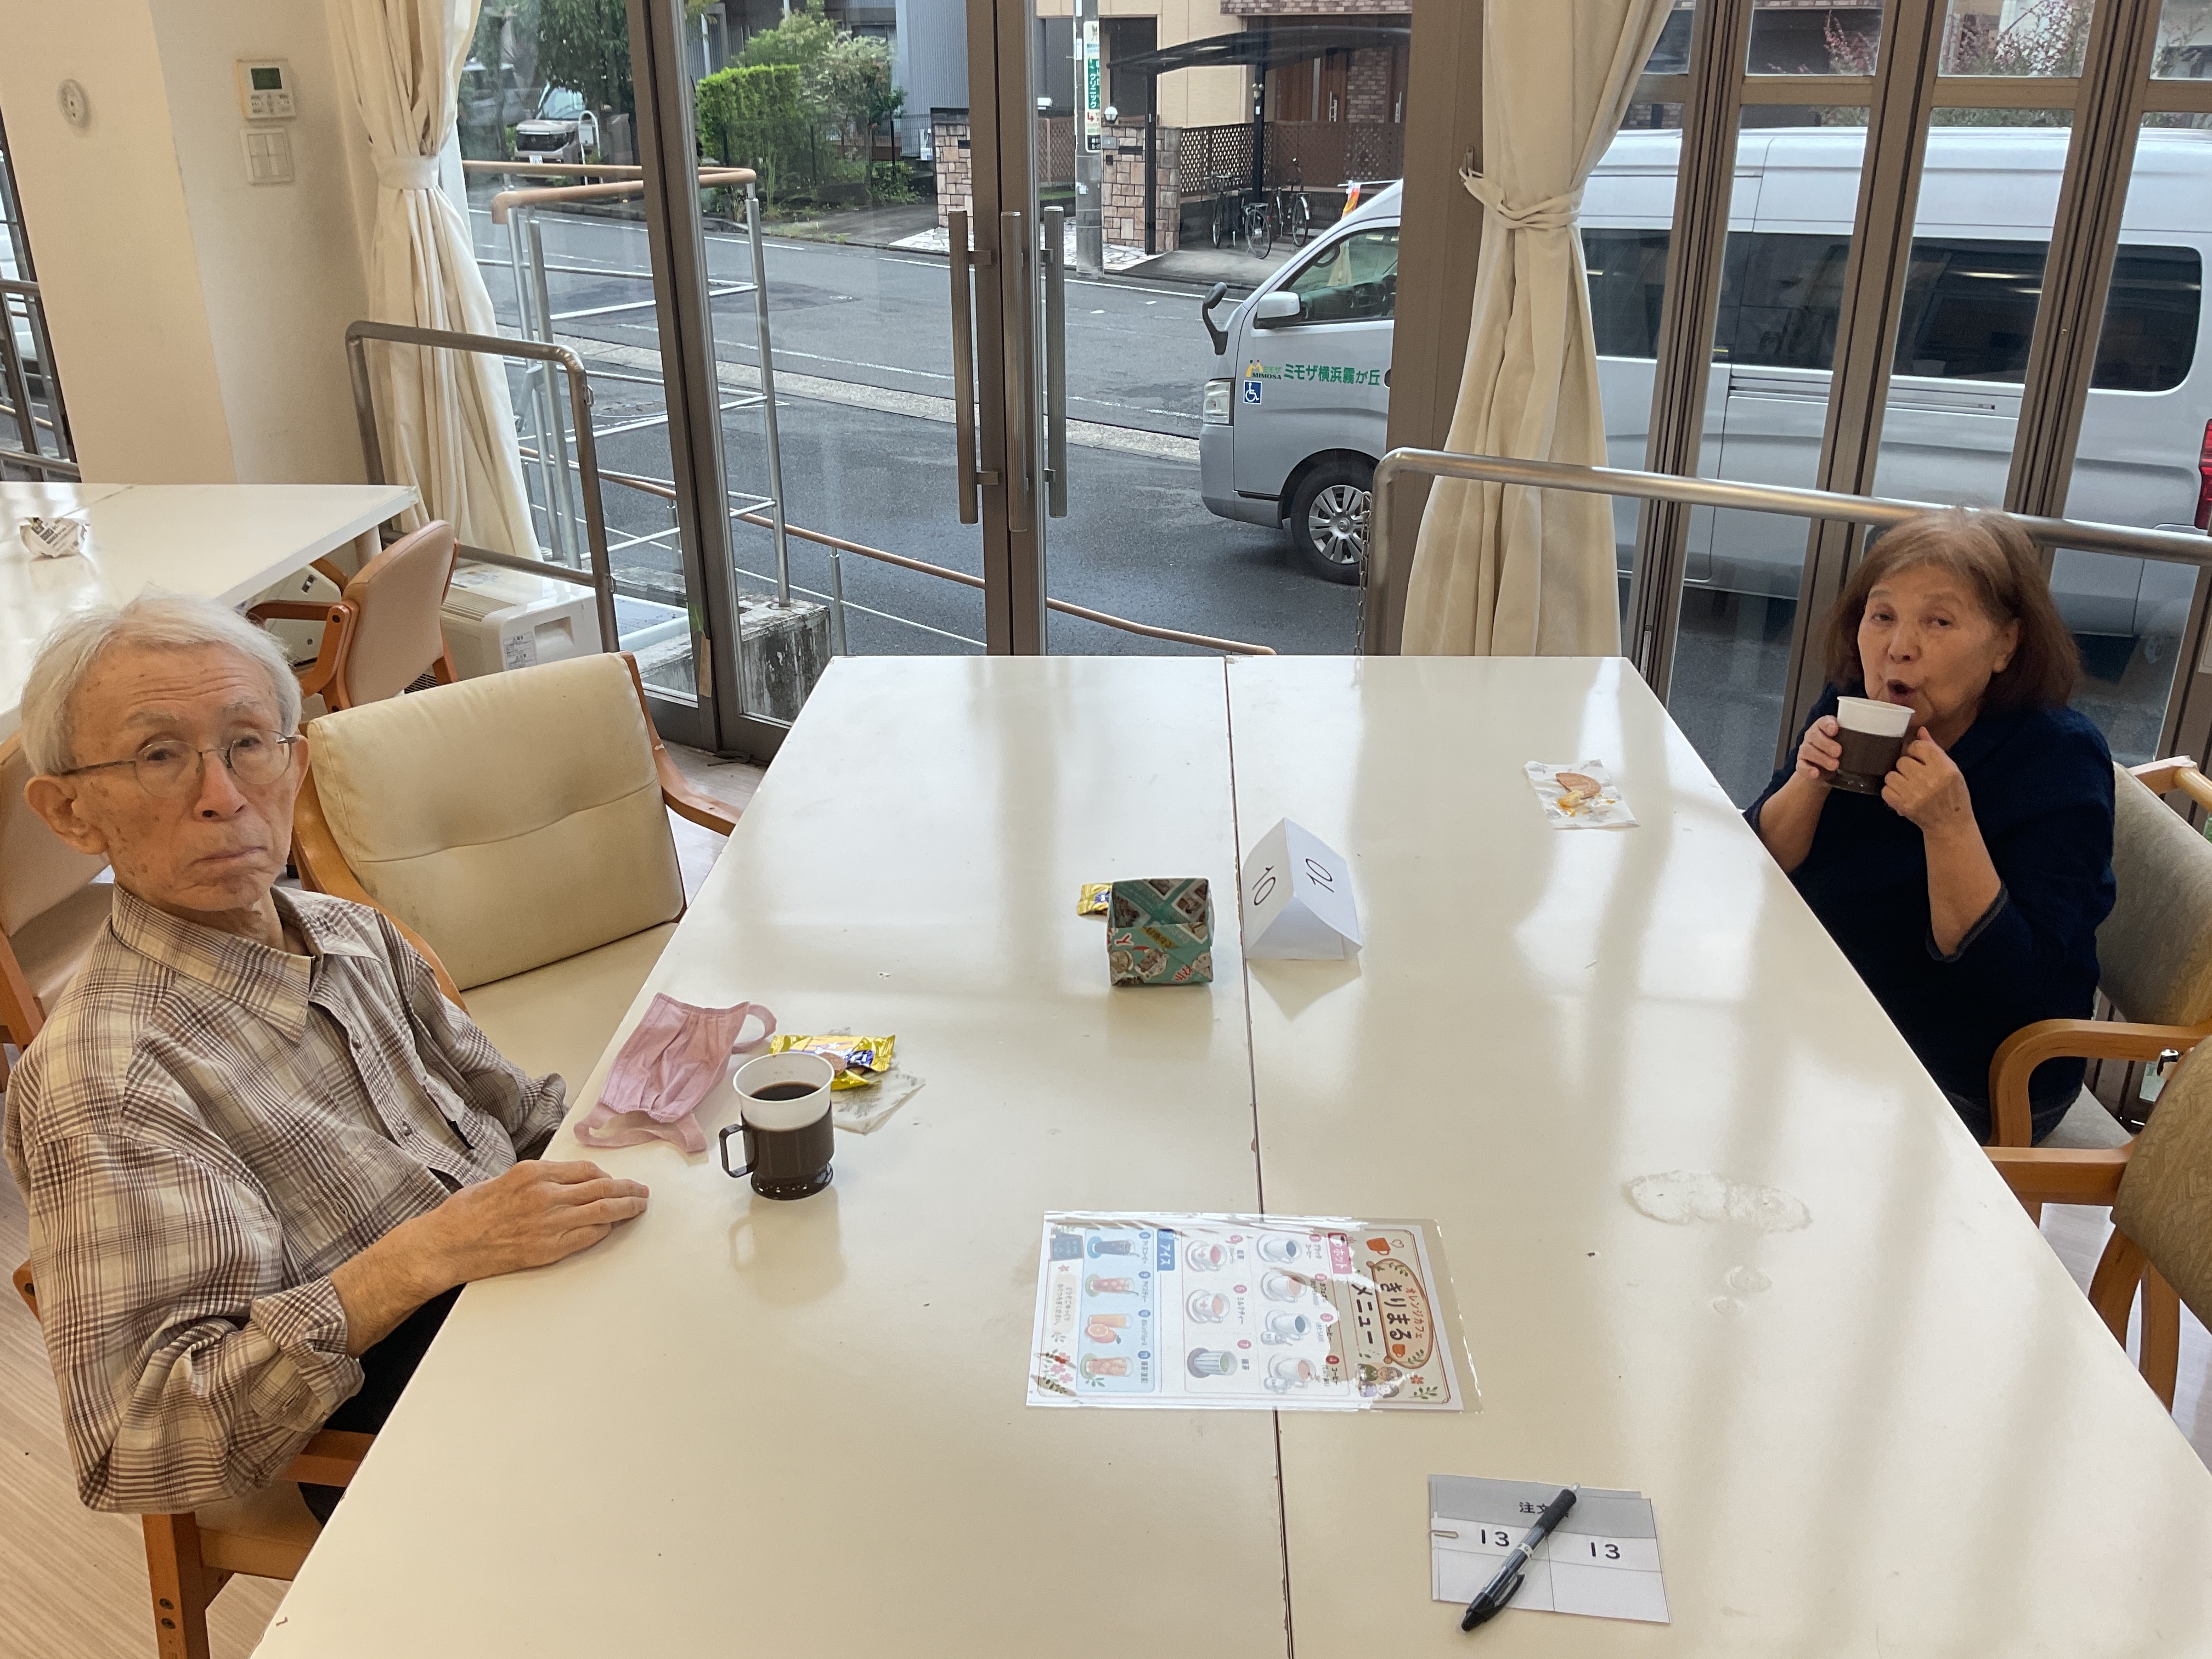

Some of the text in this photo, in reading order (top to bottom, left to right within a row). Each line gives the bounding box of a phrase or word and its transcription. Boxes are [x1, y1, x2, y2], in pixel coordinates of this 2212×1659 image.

[1284, 364, 1380, 386] ミモザ横浜霧が丘
[1305, 858, 1335, 893] 10
[1160, 1244, 1171, 1266] アイス
[1333, 1248, 1348, 1269] ホット
[1237, 1297, 1245, 1324] ミルクティー
[1351, 1284, 1373, 1344] メニュー
[1380, 1282, 1412, 1340] きりまる
[1406, 1287, 1425, 1339] オレンジカフェ
[1481, 1528, 1621, 1560] 13 13
